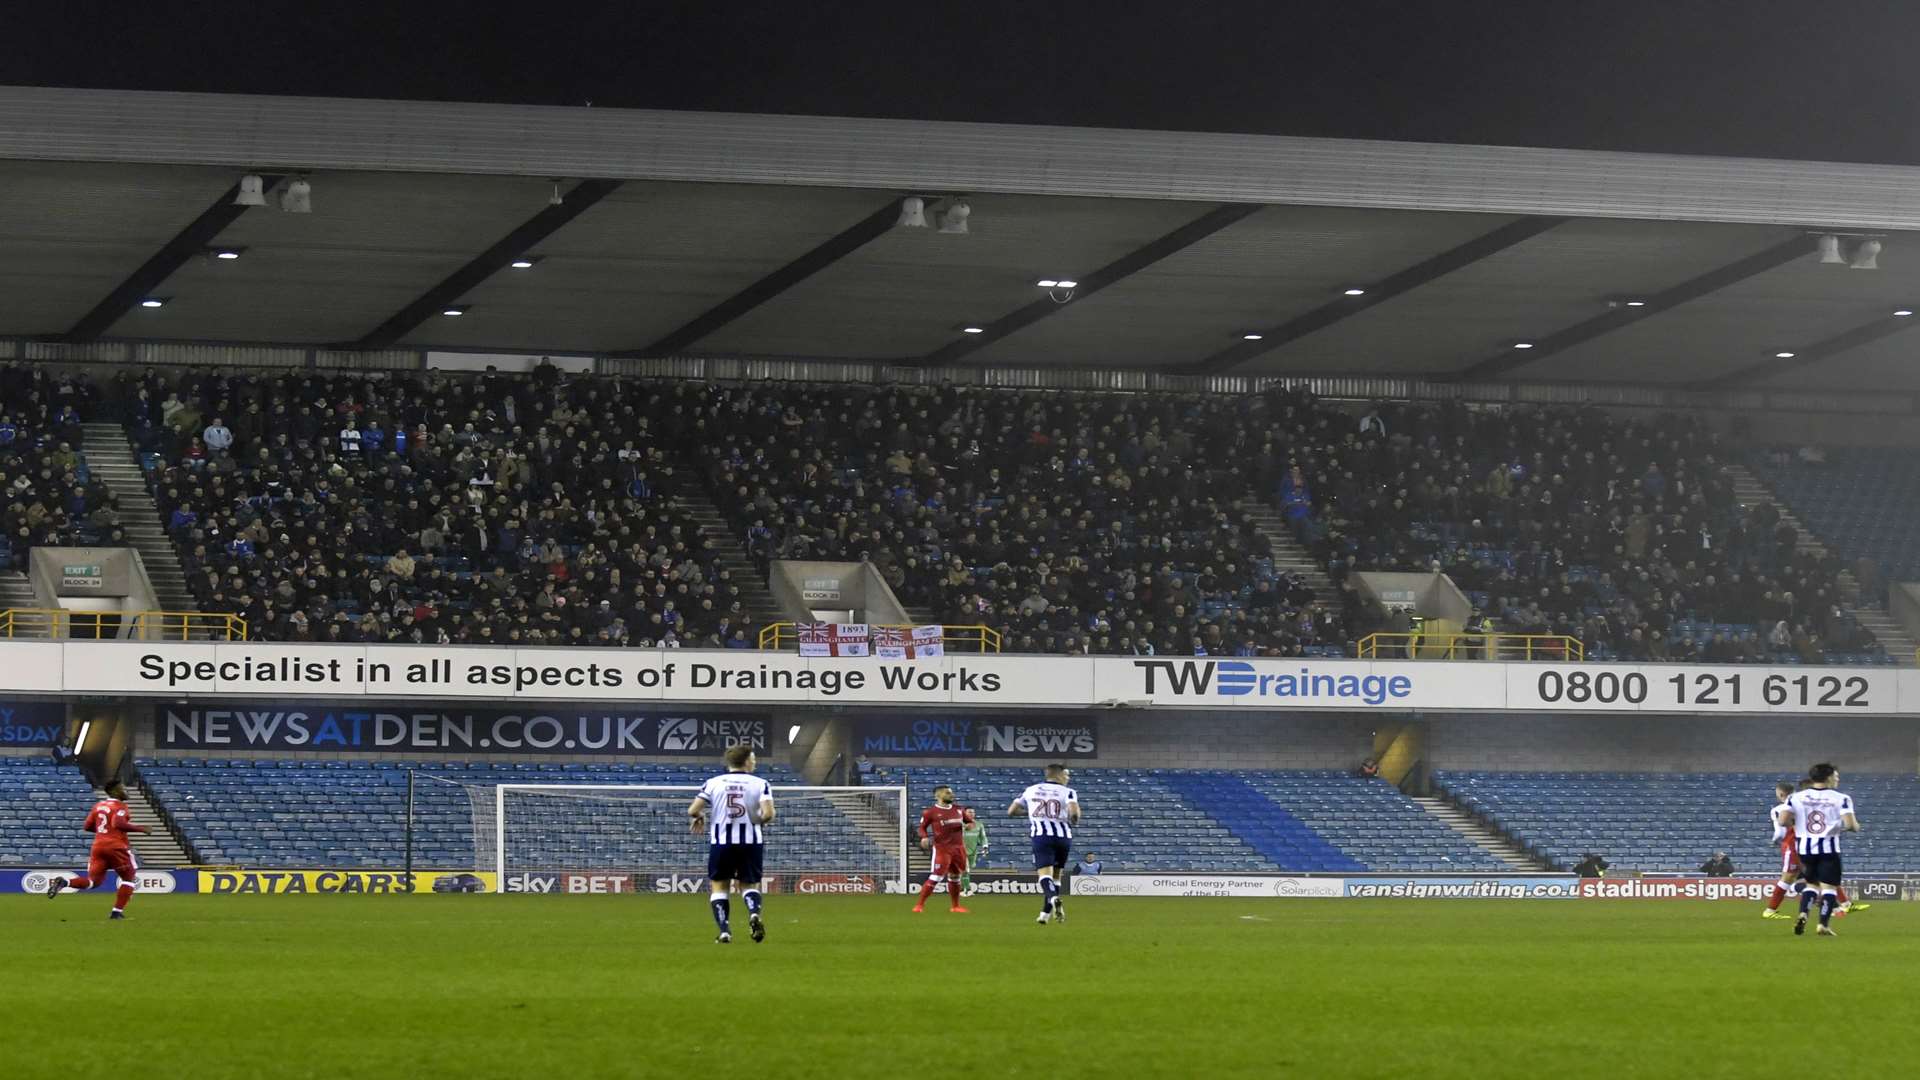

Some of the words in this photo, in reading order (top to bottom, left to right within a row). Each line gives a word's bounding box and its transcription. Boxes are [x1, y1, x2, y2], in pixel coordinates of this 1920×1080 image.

[65, 567, 87, 575] EXIT
[139, 654, 341, 686] Specialist
[357, 658, 391, 683] in
[407, 659, 451, 684] all
[467, 664, 623, 691] aspects
[637, 663, 675, 688] of
[691, 664, 865, 695] Drainage
[880, 666, 1001, 692] Works
[1537, 670, 1648, 704] 0800
[1669, 673, 1741, 705] 121
[1762, 674, 1869, 707] 6122
[0, 726, 61, 742] SDAY
[166, 710, 645, 750] NEWSATDEN.CO.UK
[703, 720, 764, 735] NEWS
[912, 720, 971, 737] ONLY
[1016, 726, 1091, 737] Southwark
[864, 736, 972, 752] MILLWALL
[984, 725, 1094, 753] News
[727, 793, 745, 818] 5
[1031, 798, 1060, 818] 20
[97, 813, 108, 833] 2
[1807, 810, 1826, 834] 8
[144, 878, 165, 888] EFL
[210, 873, 306, 893] DATA
[315, 872, 416, 893] CARS
[507, 873, 555, 893] sky
[568, 876, 628, 893] BET
[656, 874, 703, 893] sky
[1152, 879, 1188, 887] Official
[1191, 880, 1226, 889] Energy
[1228, 880, 1264, 888] Partner
[1583, 879, 1798, 899] stadium-signage
